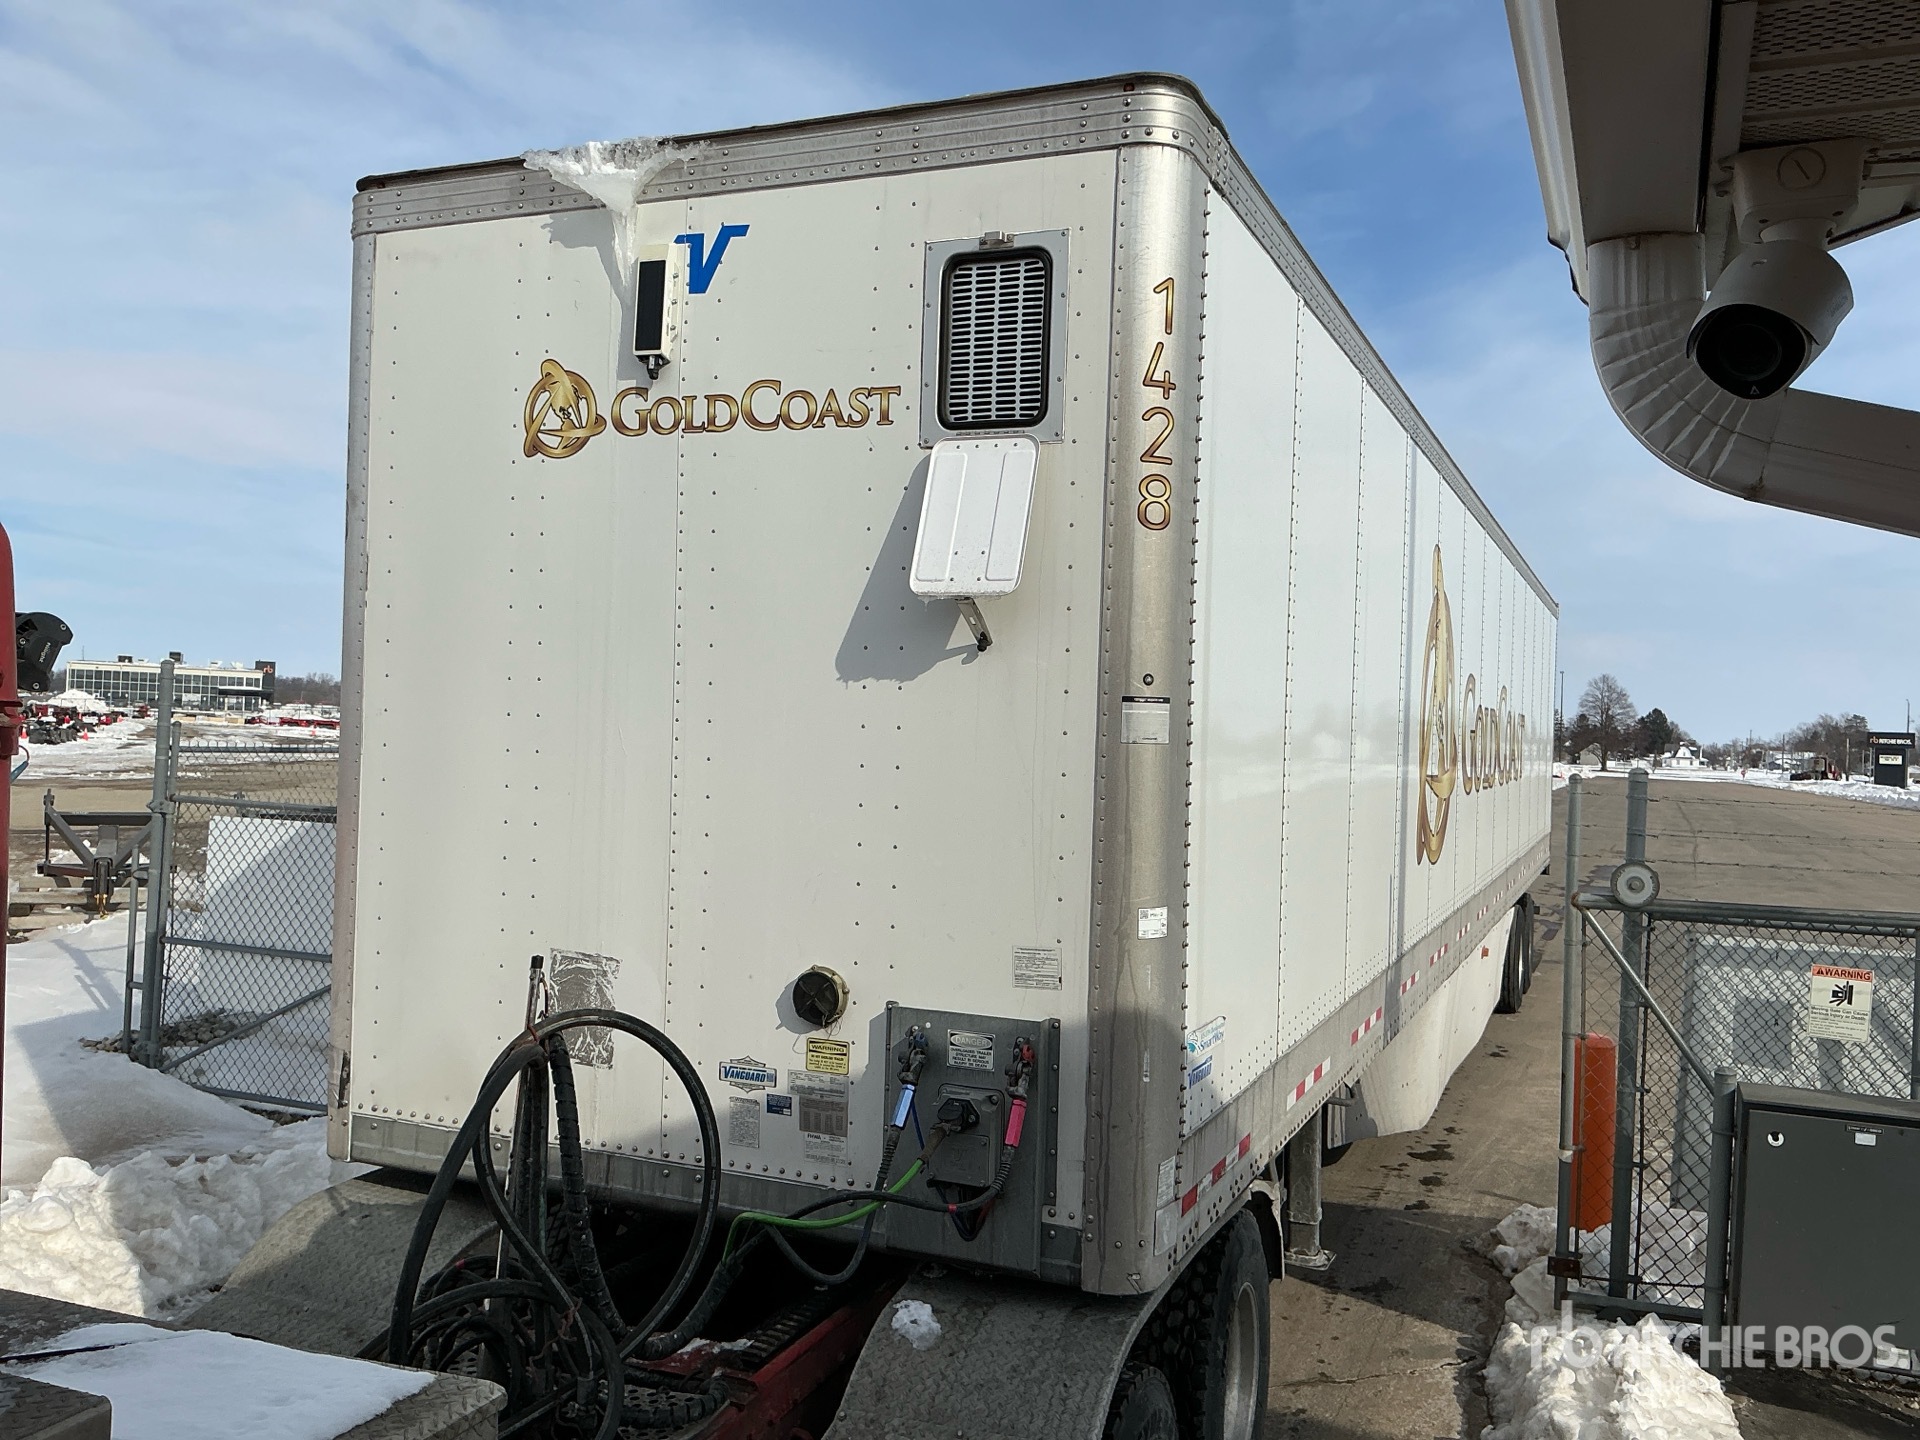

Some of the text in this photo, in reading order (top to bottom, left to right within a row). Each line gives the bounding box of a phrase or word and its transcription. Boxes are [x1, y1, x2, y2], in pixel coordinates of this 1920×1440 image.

[1824, 968, 1871, 981] WARNING
[955, 1036, 988, 1047] DANGER
[722, 1066, 767, 1082] VANGUARD
